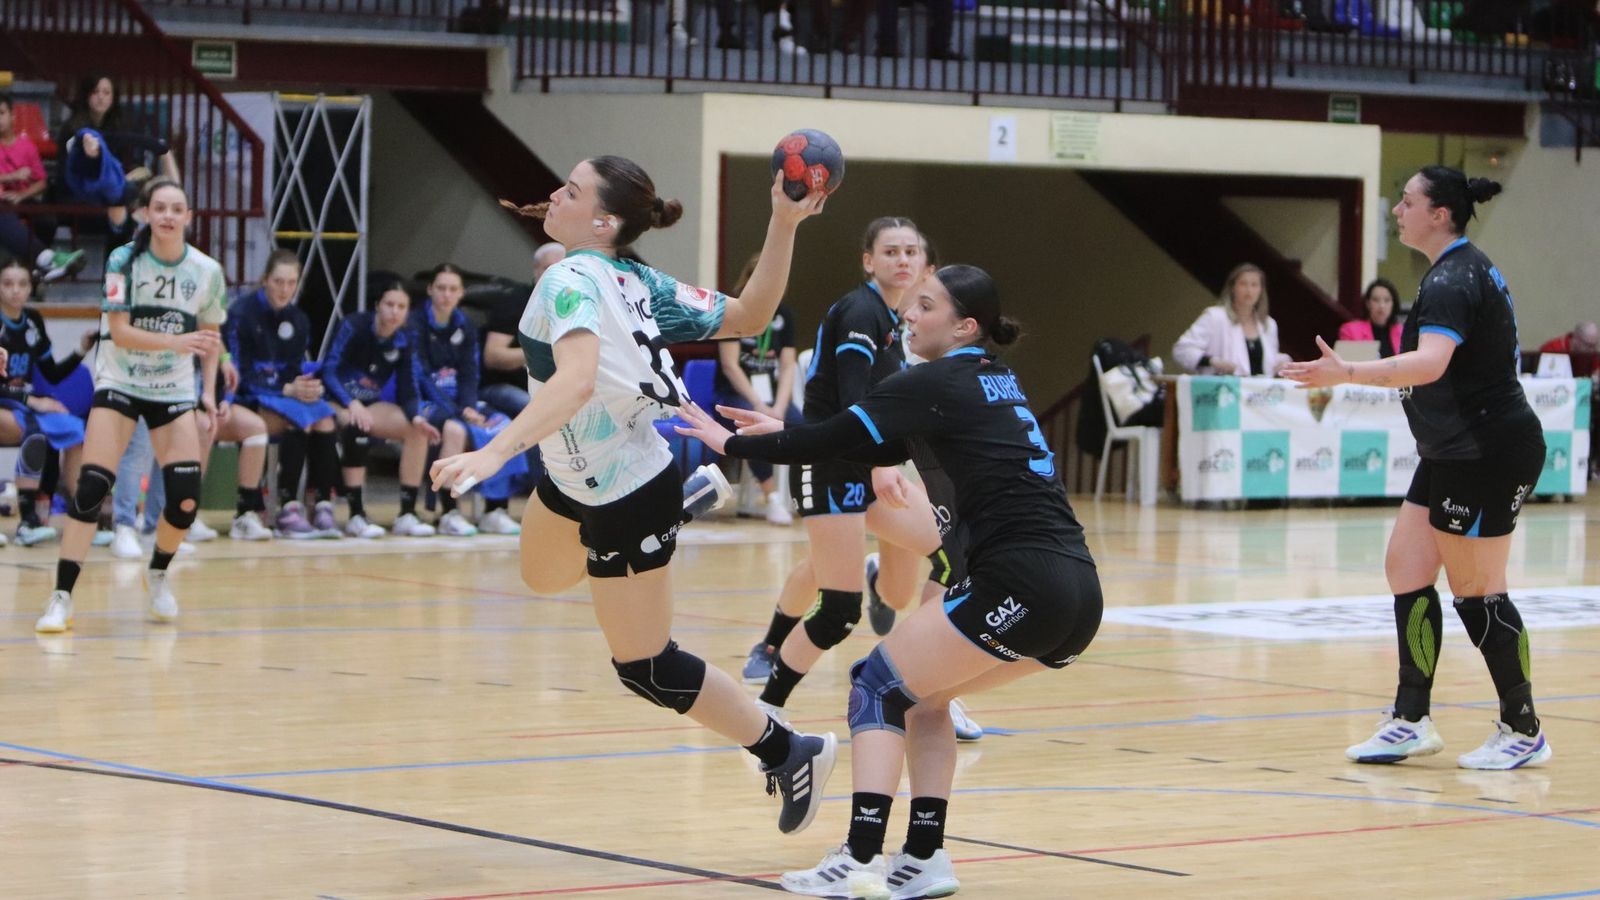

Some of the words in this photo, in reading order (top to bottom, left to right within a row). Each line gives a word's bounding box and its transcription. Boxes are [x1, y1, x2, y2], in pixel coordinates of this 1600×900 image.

[998, 125, 1009, 145] 2
[153, 275, 176, 299] 21
[133, 315, 185, 335] atticgo
[1013, 405, 1055, 477] 3
[842, 482, 866, 507] 20
[1446, 503, 1470, 514] LUNA
[985, 595, 1022, 627] GAZ
[995, 607, 1029, 635] nutrition
[854, 815, 882, 824] erima
[912, 819, 940, 827] erima
